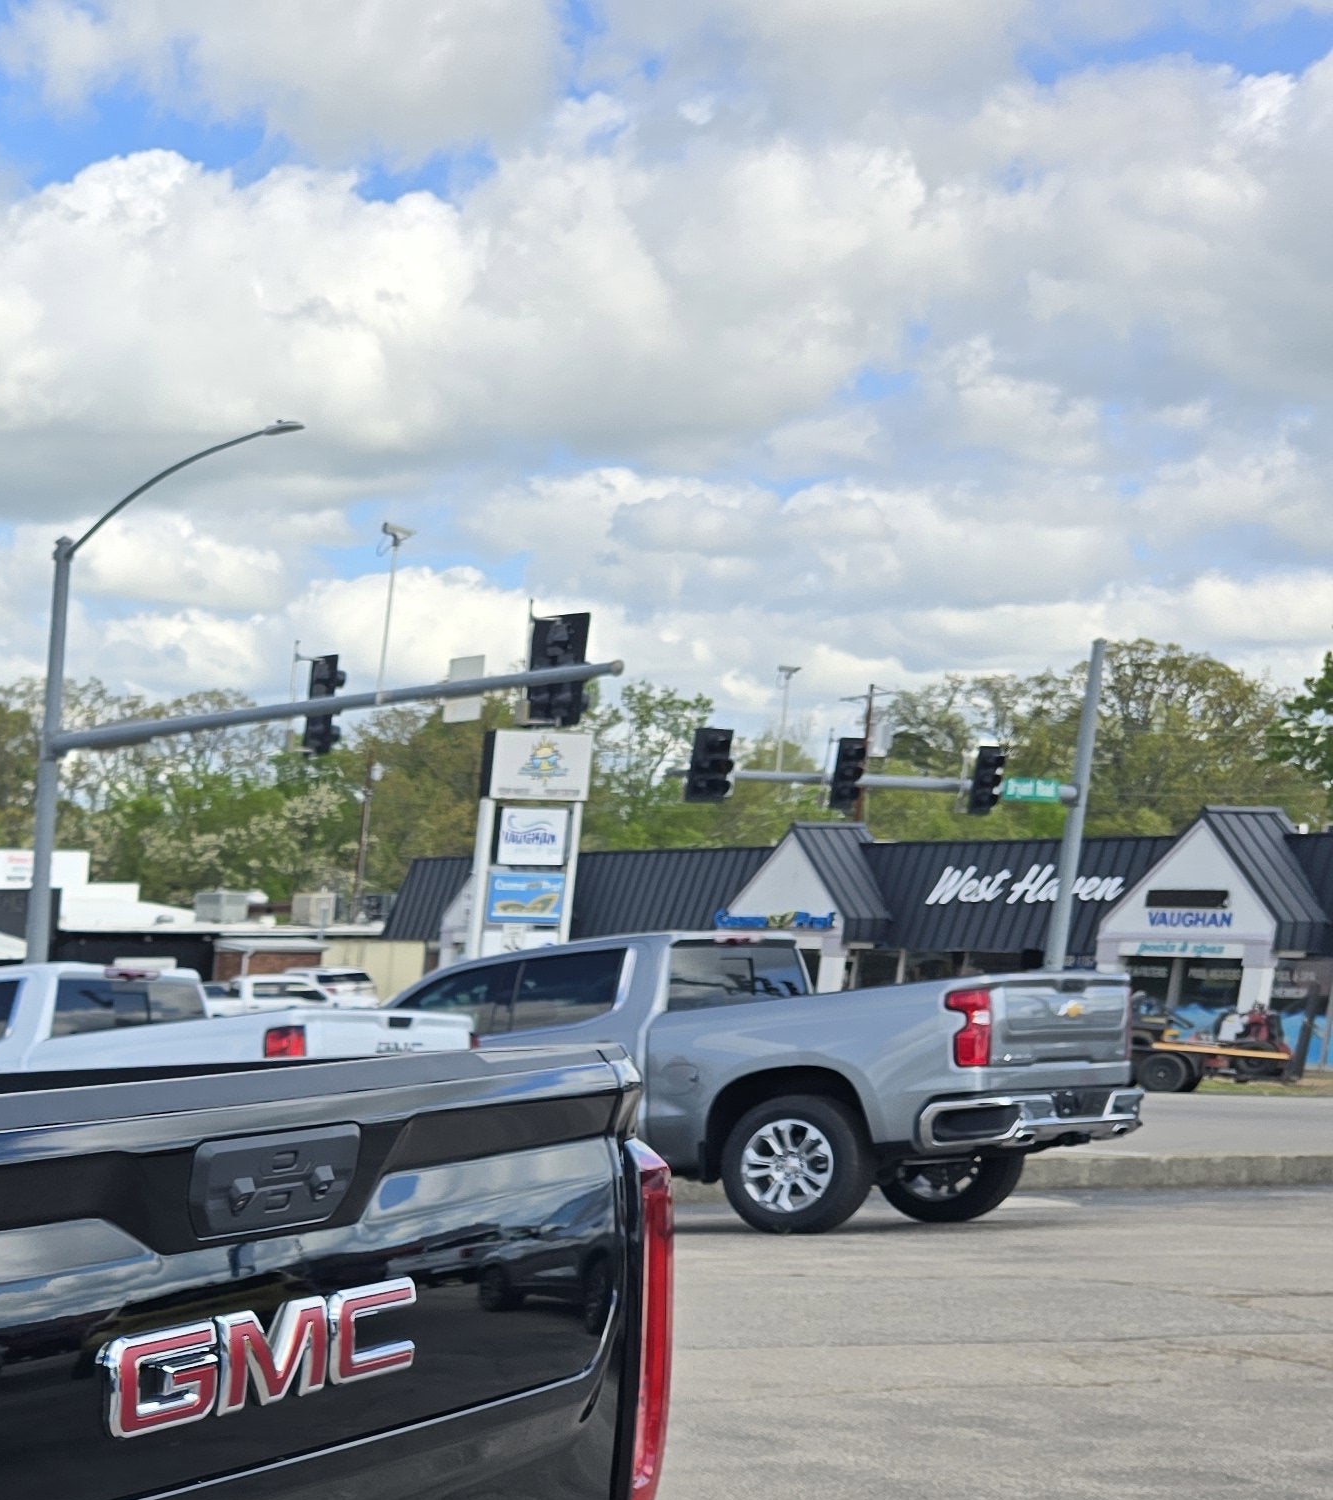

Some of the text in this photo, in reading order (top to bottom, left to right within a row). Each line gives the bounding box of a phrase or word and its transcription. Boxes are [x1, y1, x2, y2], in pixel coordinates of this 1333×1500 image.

[925, 865, 1012, 905] West
[1148, 911, 1233, 928] VAUGHAN
[96, 1277, 417, 1438] GMC
